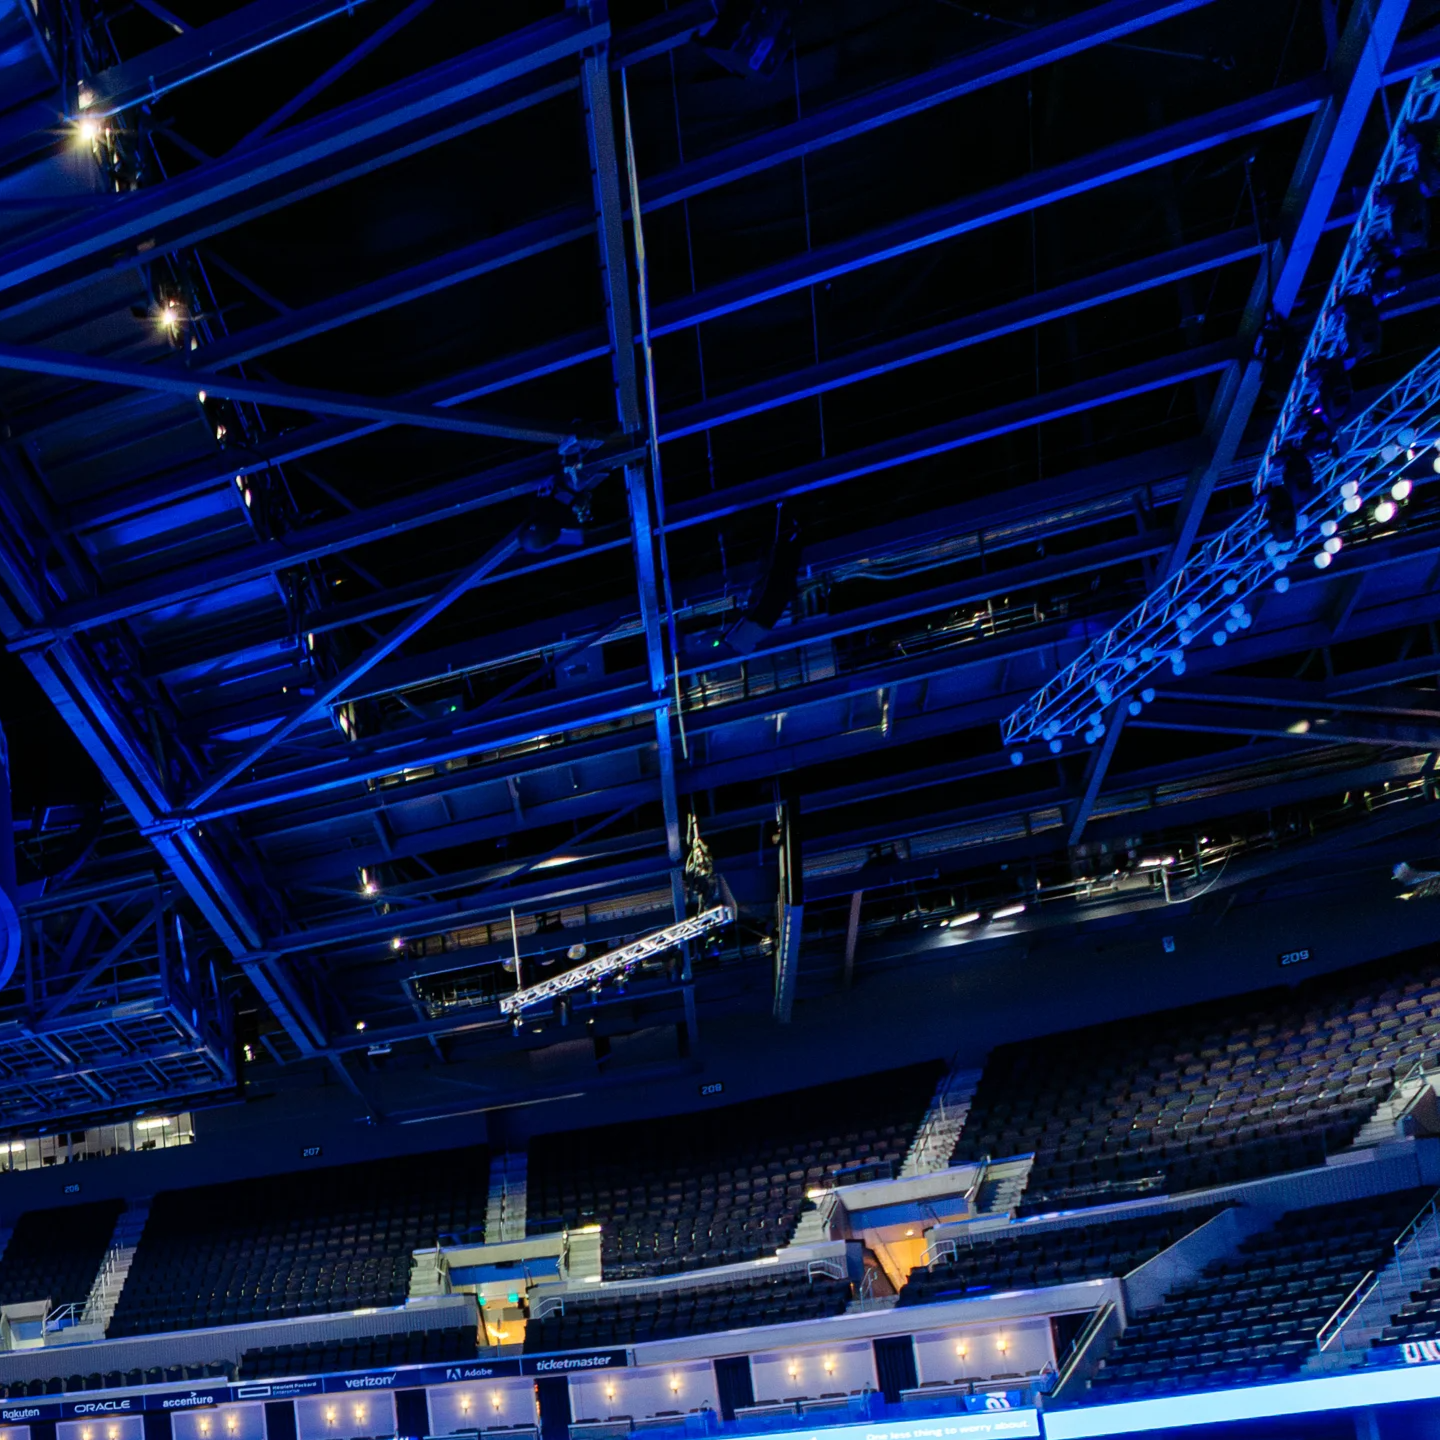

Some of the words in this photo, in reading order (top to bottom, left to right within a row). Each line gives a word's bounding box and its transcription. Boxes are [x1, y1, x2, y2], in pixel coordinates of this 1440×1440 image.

[1281, 949, 1310, 965] 209
[702, 1083, 723, 1095] 208
[303, 1147, 320, 1157] 207
[536, 1357, 612, 1370] ticketmaster
[464, 1368, 494, 1378] Adobe
[344, 1376, 392, 1389] verizon
[74, 1400, 132, 1414] ORACLE
[162, 1394, 214, 1409] accenture
[2, 1407, 40, 1420] Rakuten
